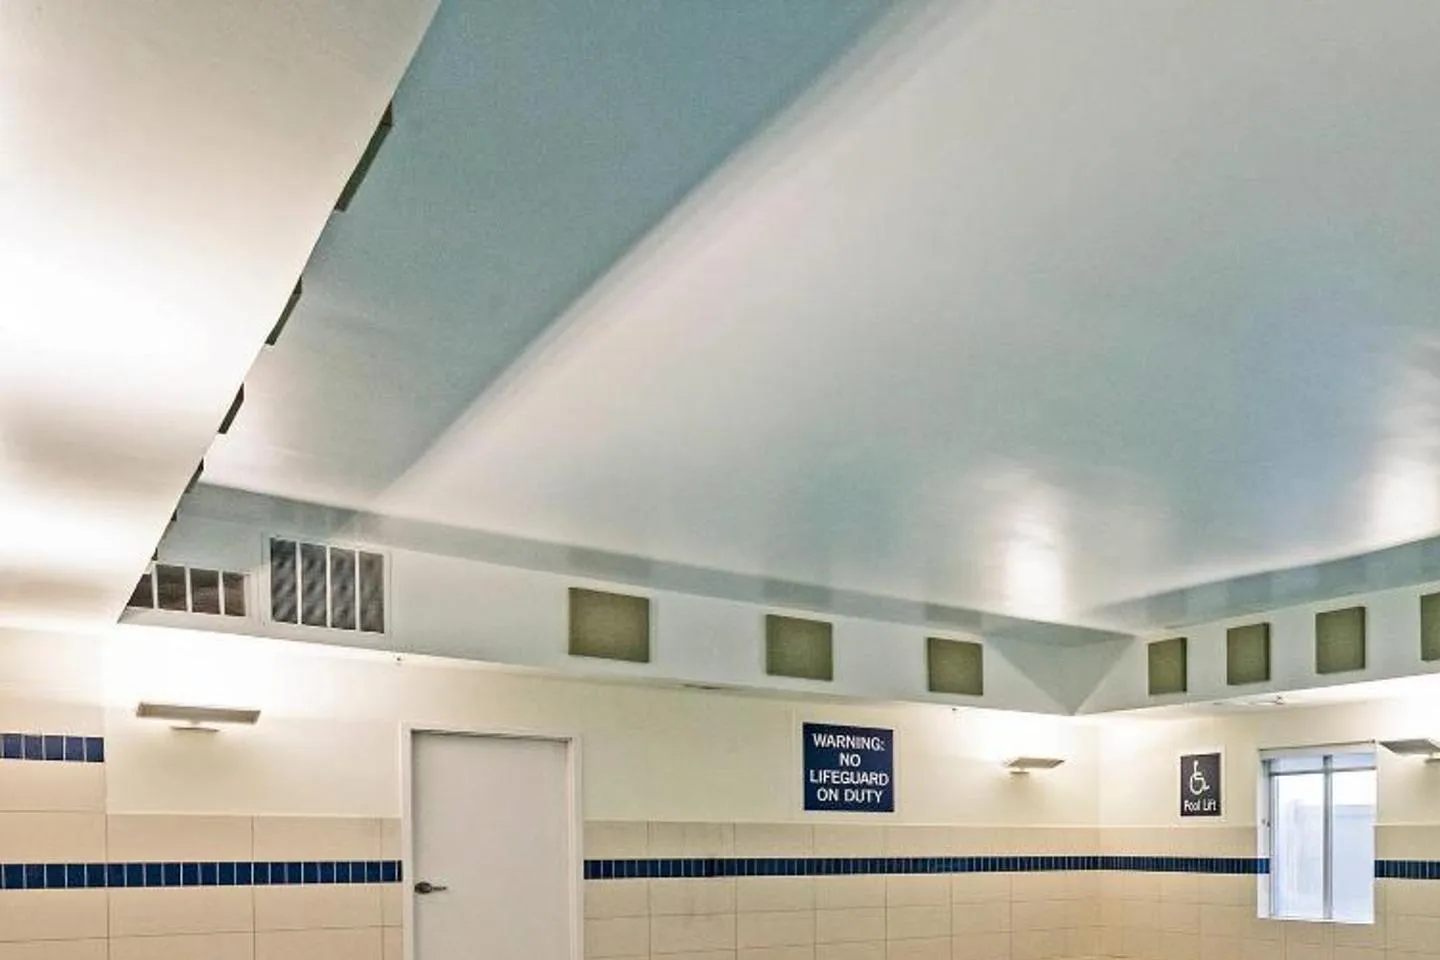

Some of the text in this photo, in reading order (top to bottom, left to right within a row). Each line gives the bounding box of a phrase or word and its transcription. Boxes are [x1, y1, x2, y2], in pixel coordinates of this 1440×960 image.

[812, 732, 885, 751] WARNING:
[839, 752, 861, 767] NO
[809, 769, 890, 786] LIFEGUARD
[817, 787, 883, 804] ON DUTY
